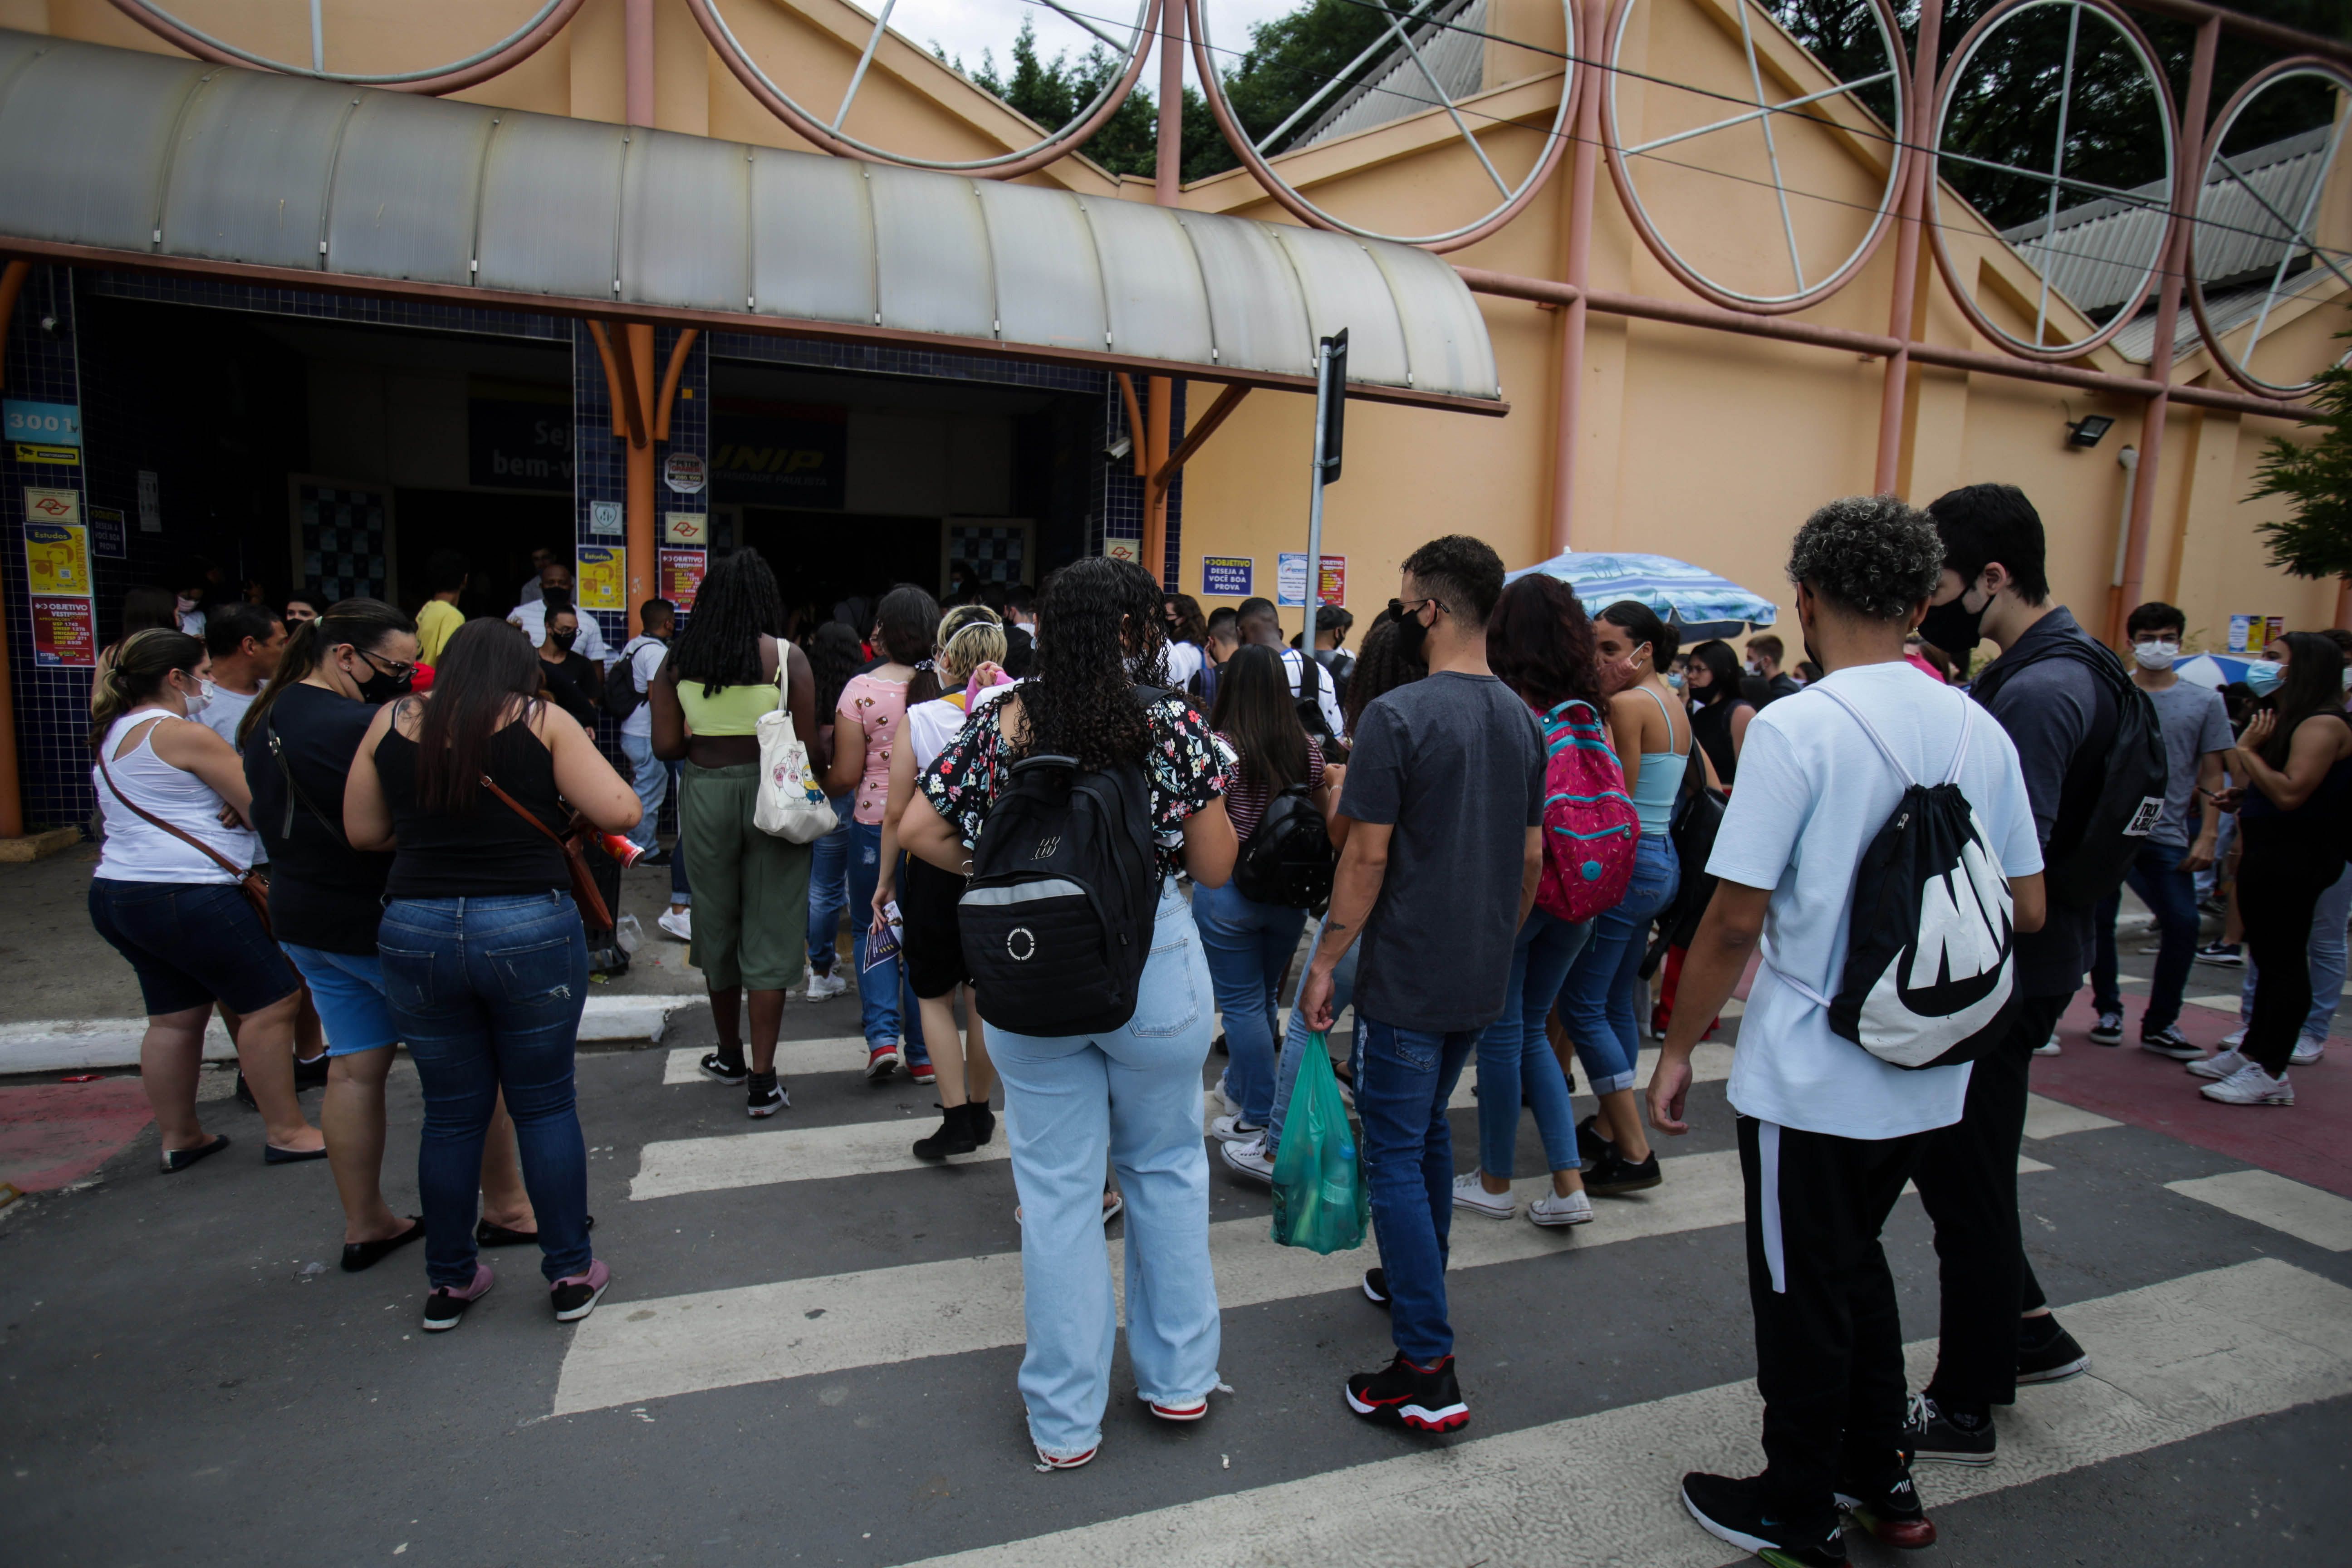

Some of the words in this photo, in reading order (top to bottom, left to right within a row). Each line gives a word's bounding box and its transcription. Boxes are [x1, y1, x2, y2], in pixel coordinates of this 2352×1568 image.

[9, 413, 73, 432] 3001
[534, 420, 573, 454] Sej
[493, 448, 574, 480] bem-v
[1216, 559, 1250, 567] OBJETIVO
